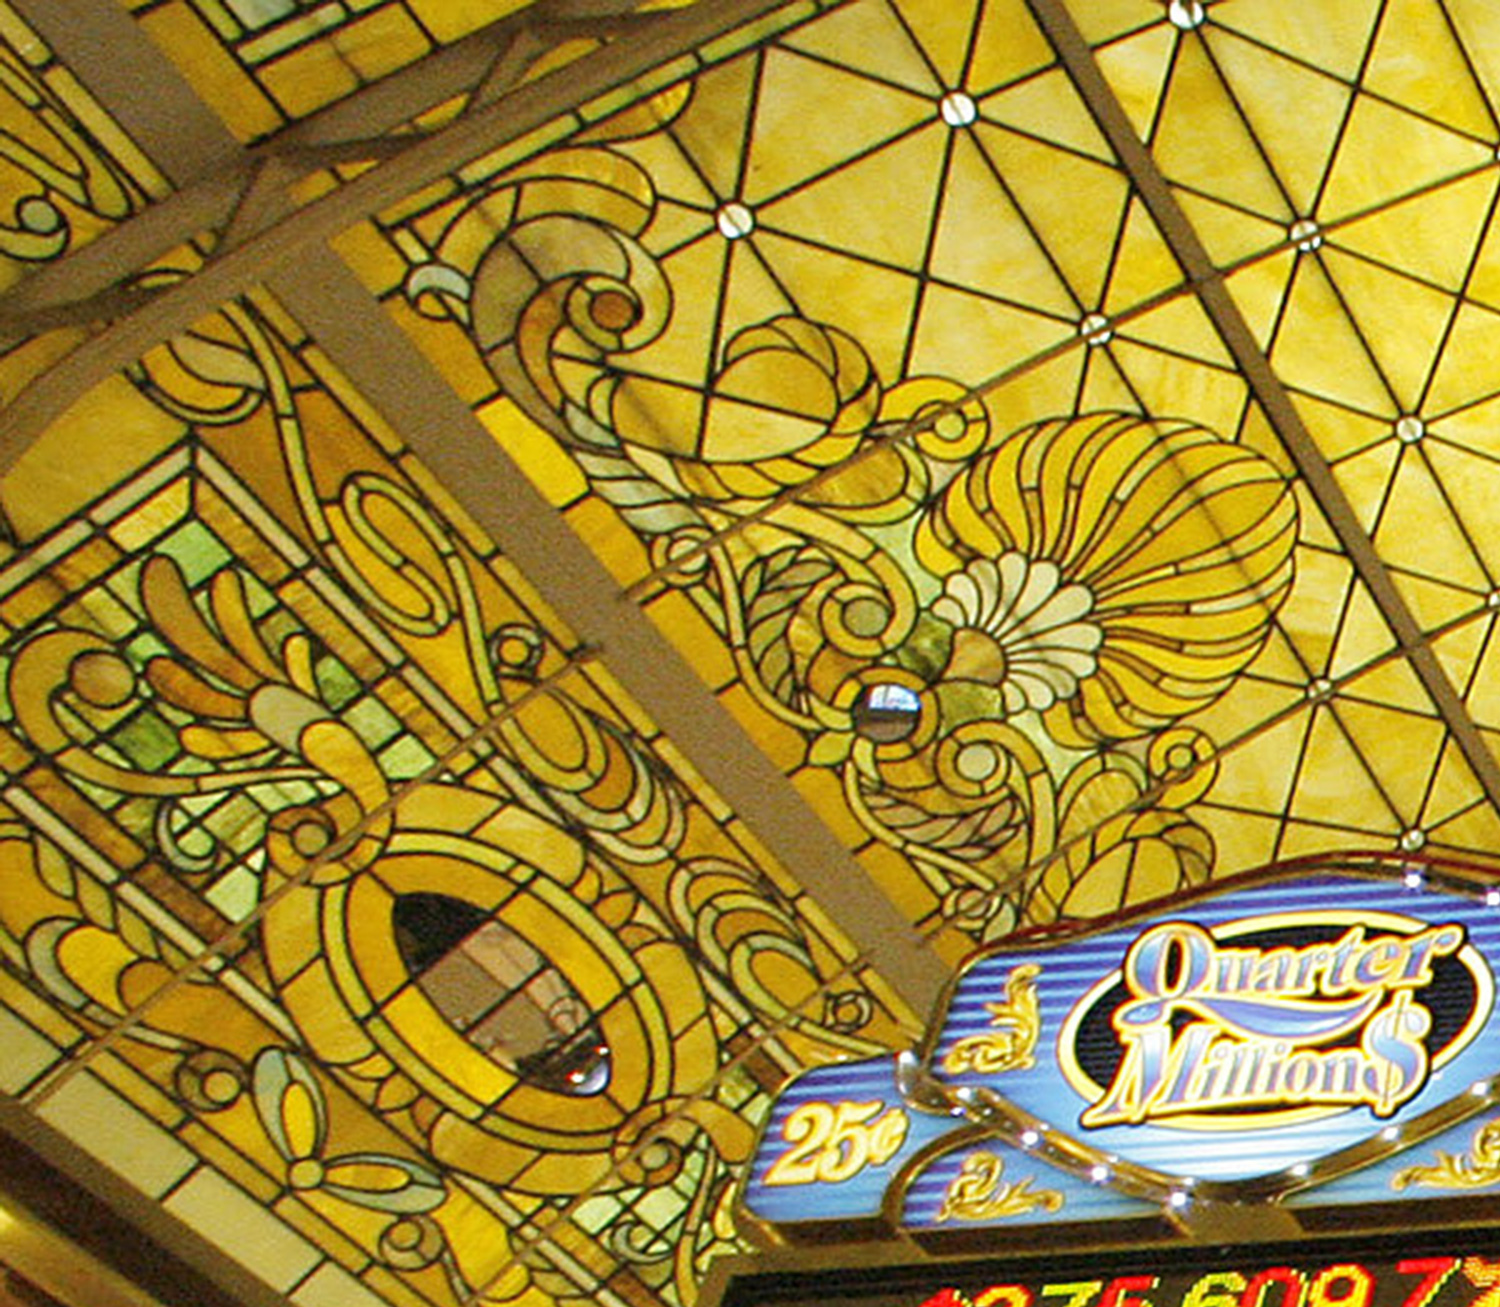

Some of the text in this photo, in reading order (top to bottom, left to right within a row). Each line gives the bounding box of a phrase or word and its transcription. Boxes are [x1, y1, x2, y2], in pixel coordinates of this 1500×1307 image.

[1125, 918, 1464, 1006] Quarter
[1081, 996, 1432, 1124] Million$
[761, 1096, 906, 1187] 25¢
